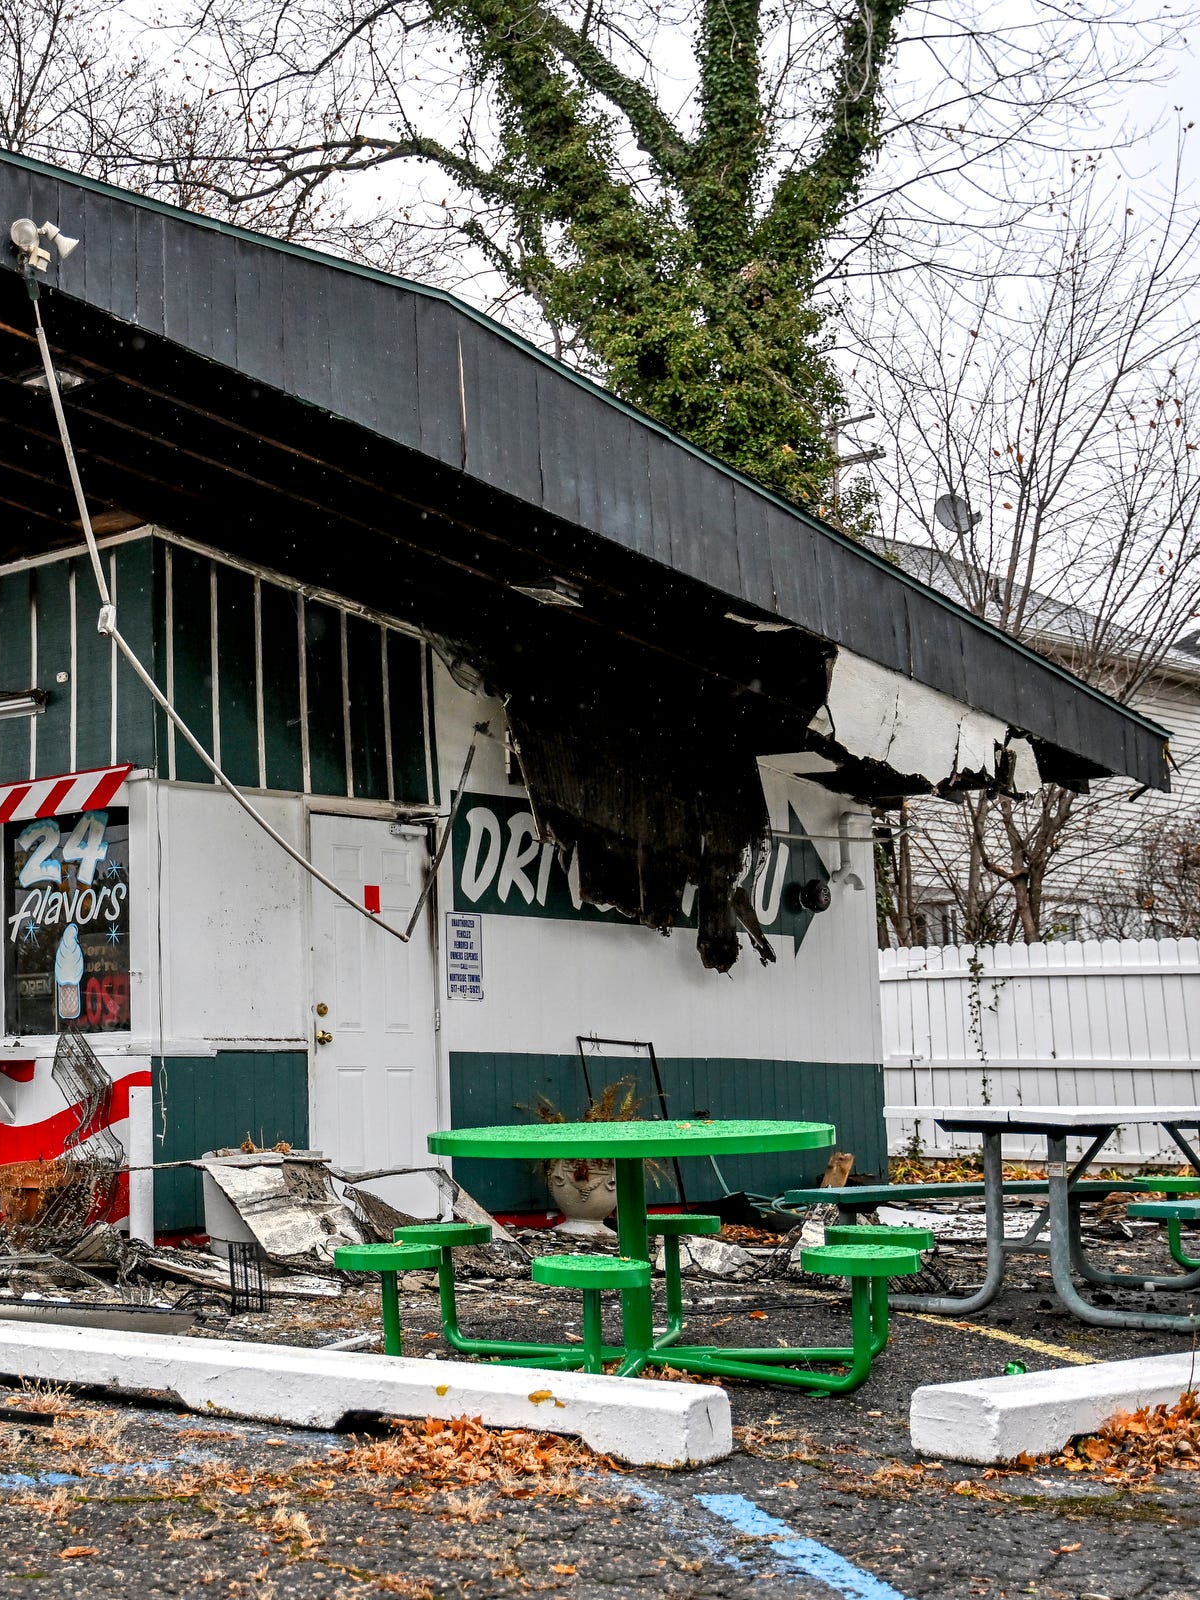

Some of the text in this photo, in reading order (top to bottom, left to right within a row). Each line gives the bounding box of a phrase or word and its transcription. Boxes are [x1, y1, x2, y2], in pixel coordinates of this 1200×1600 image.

[19, 810, 109, 888] 24
[464, 952, 479, 961] EXPENSE
[18, 978, 52, 996] OPEN
